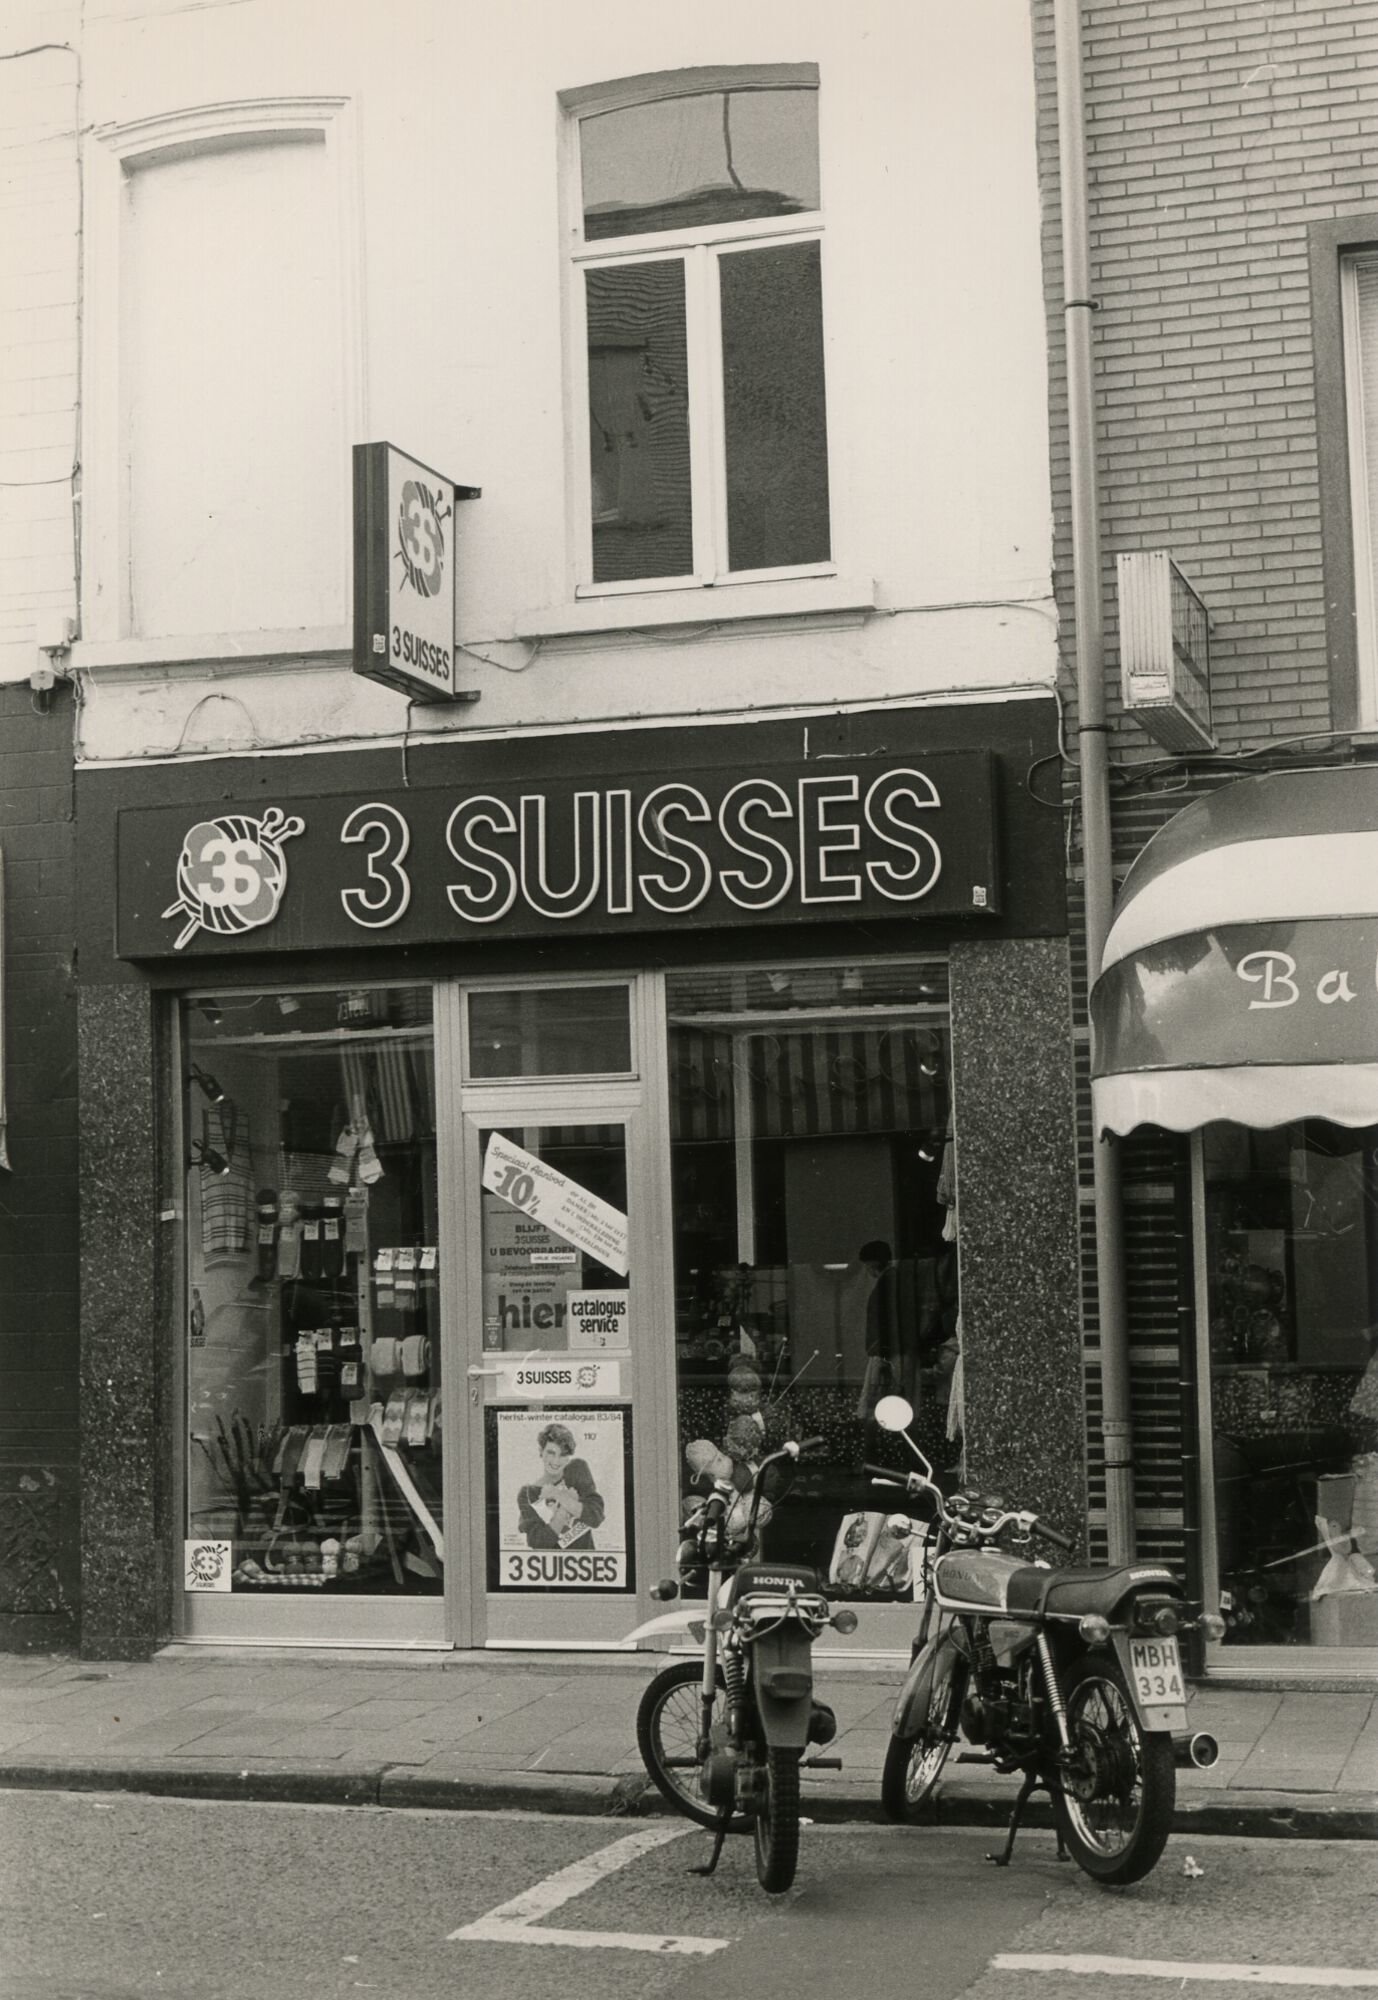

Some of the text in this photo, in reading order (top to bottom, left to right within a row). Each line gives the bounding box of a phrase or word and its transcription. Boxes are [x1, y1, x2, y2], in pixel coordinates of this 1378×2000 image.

[392, 626, 450, 681] 3 SUISSES
[340, 766, 943, 929] 3 SUISSES
[1236, 949, 1378, 1010] Ba
[490, 1248, 497, 1256] U
[498, 1295, 567, 1329] hier
[571, 1299, 626, 1319] catalogus
[580, 1318, 619, 1333] service
[516, 1370, 572, 1385] 3 SUISSES
[554, 1413, 595, 1423] catalogus
[508, 1555, 618, 1583] 3 SUISSES
[1129, 1569, 1172, 1580] HONDA
[752, 1576, 805, 1588] HONDA
[1133, 1644, 1176, 1669] MBH
[1138, 1676, 1182, 1698] 334
